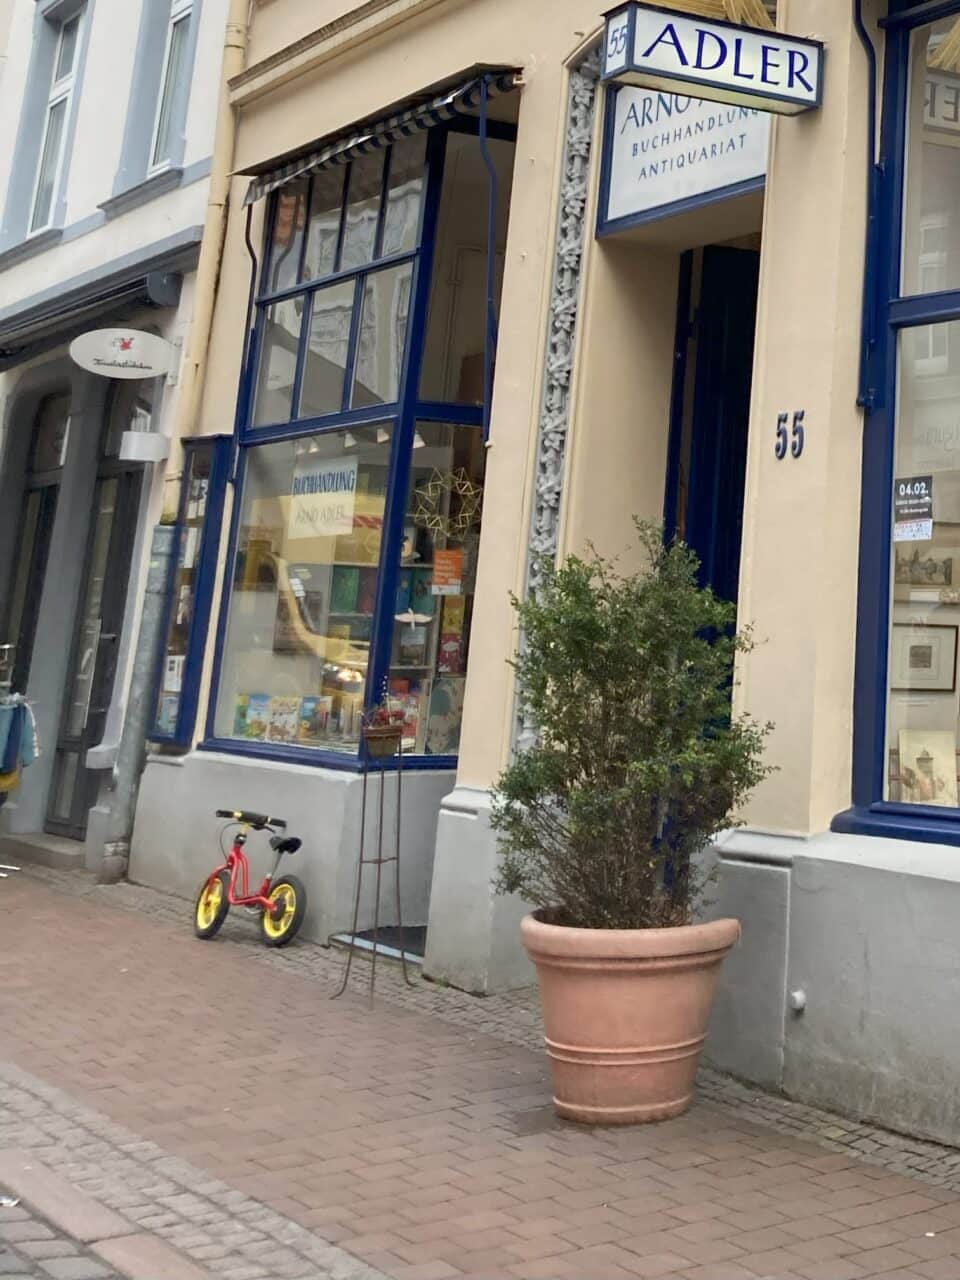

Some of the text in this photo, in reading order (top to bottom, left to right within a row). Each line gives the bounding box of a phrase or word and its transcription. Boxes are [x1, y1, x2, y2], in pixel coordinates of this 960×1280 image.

[607, 25, 628, 58] 55
[641, 23, 815, 93] ADLER
[620, 93, 692, 135] ARNO
[639, 133, 748, 181] ANTIQUARIAT
[775, 409, 805, 460] 55
[292, 470, 356, 496] BUCHHANDLUNG
[899, 481, 929, 497] 04.02.
